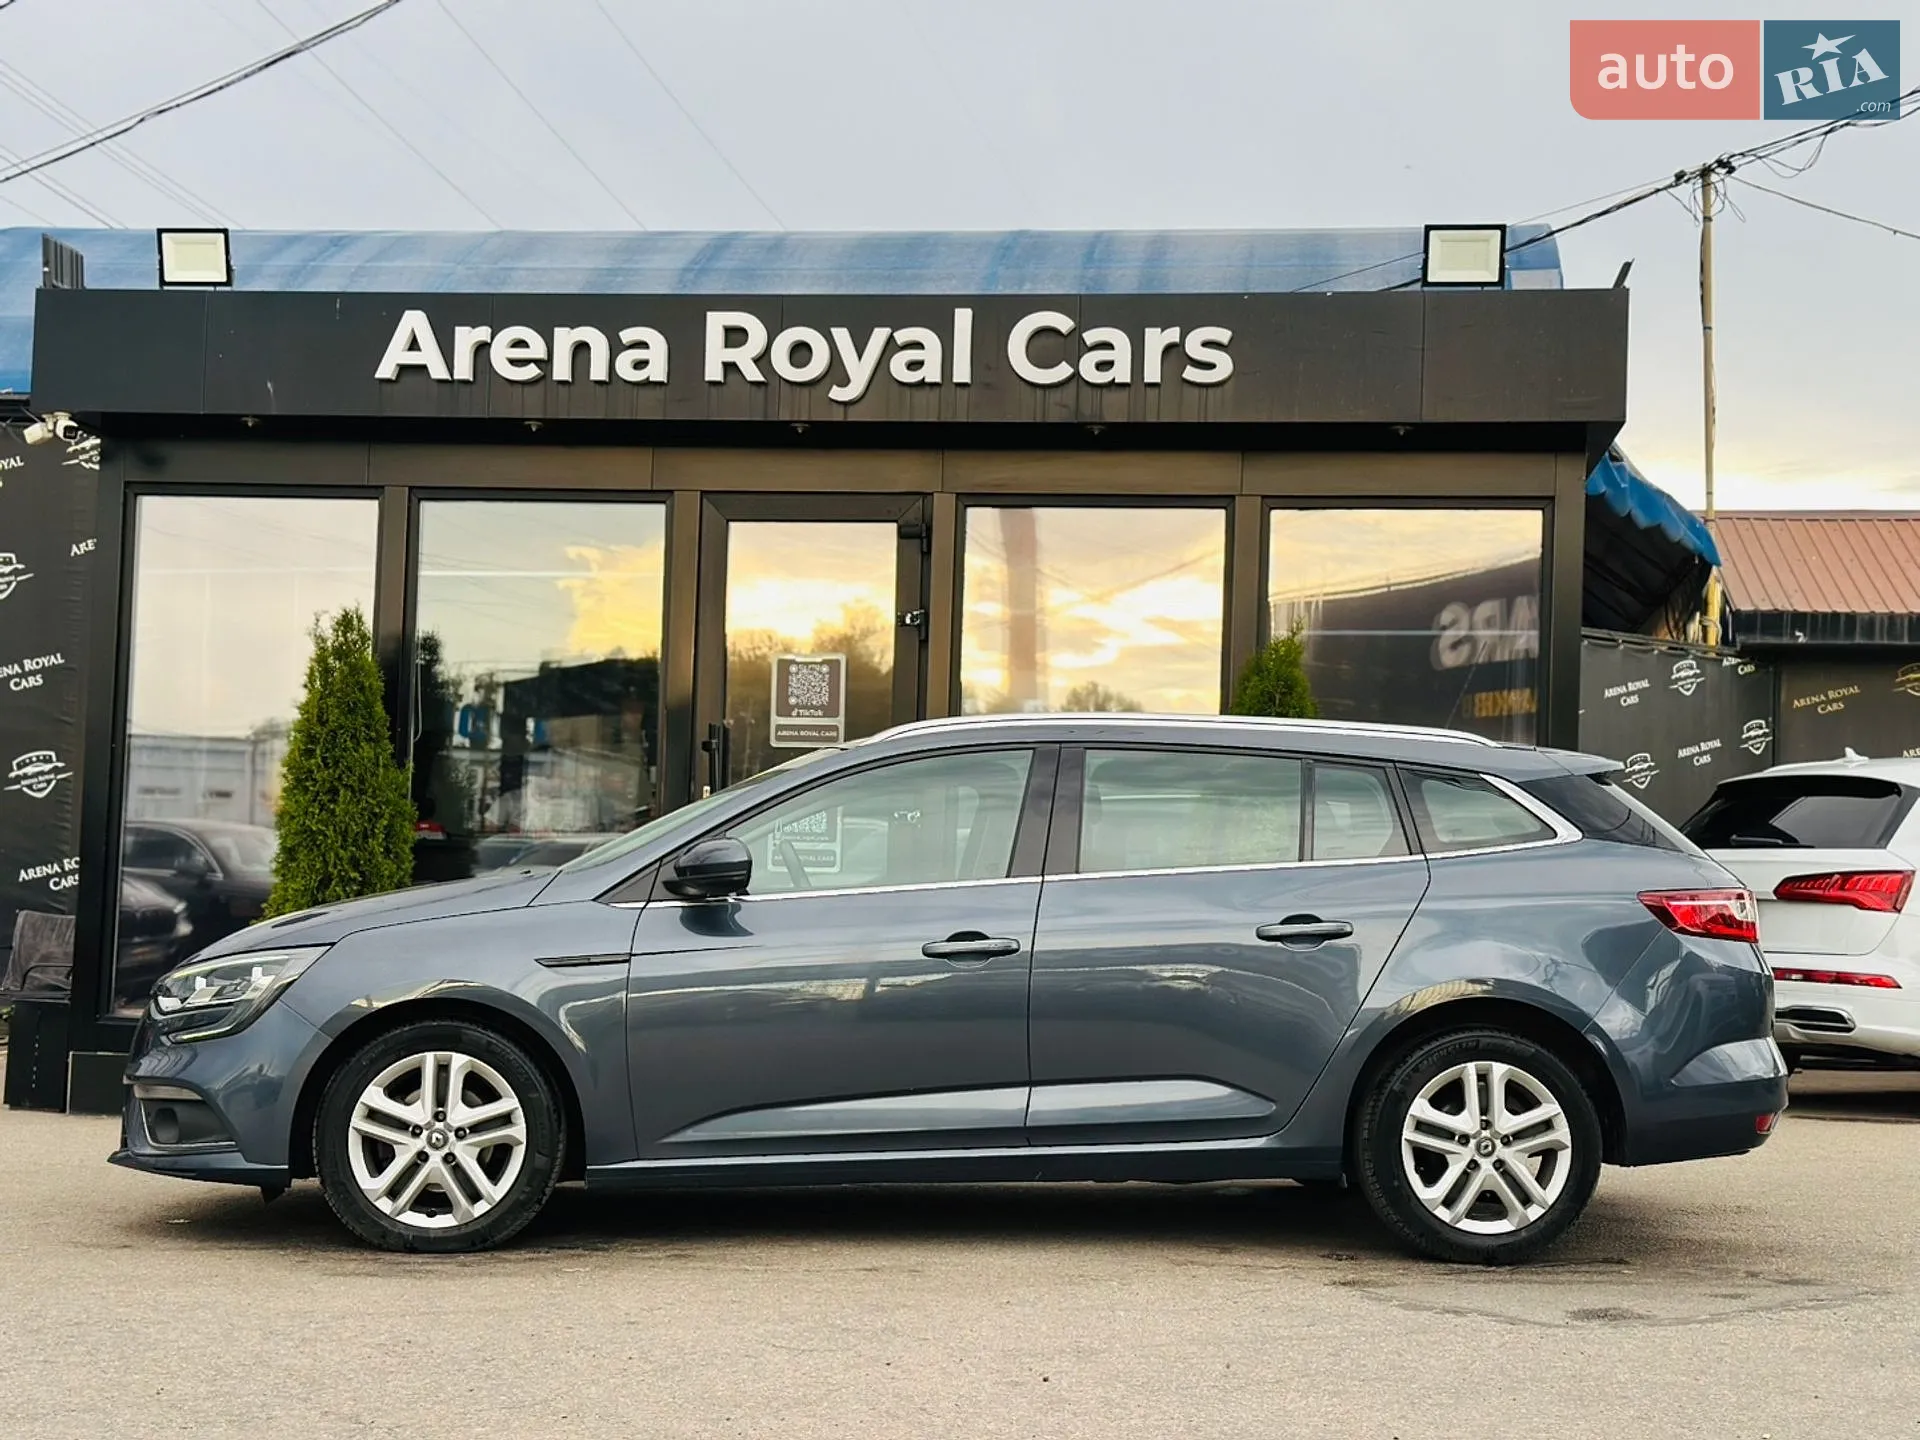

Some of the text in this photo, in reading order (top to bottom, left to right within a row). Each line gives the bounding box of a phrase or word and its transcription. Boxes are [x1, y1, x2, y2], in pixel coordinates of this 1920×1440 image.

[375, 307, 1234, 403] Arena Royal Cars
[0, 456, 24, 470] YAL
[70, 539, 97, 557] ARE
[23, 653, 65, 671] ROYAL
[9, 674, 43, 691] CARS
[1793, 685, 1860, 708] ARENA ROYAL
[1817, 702, 1845, 714] CARS
[18, 862, 61, 882] ARENA
